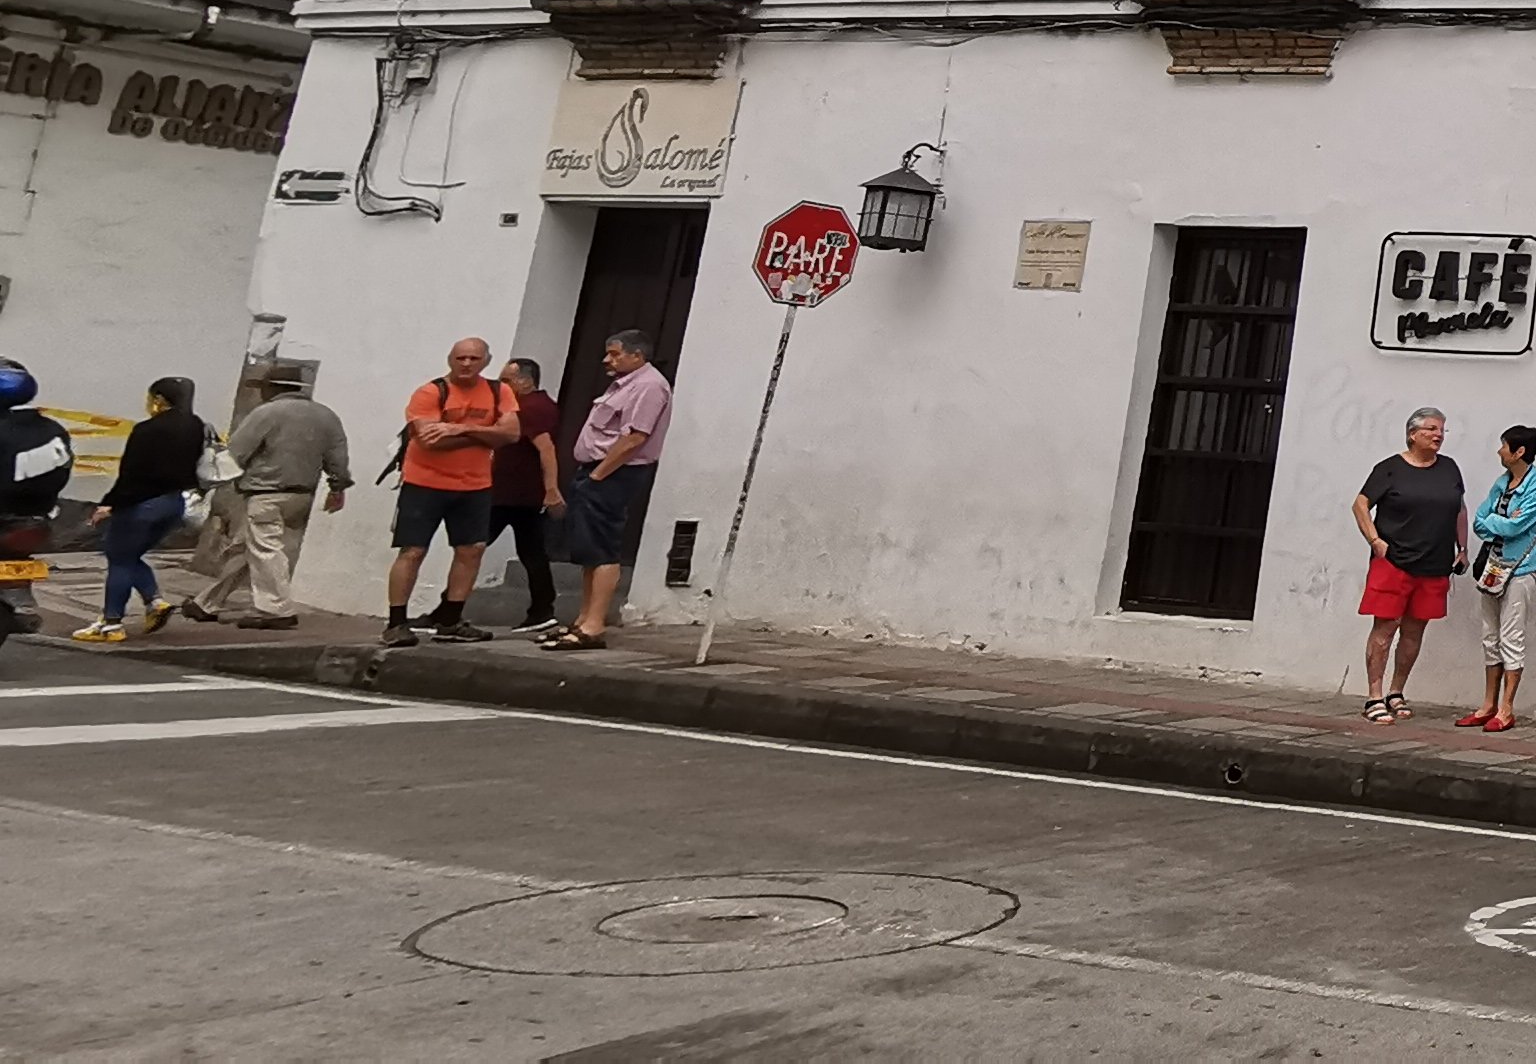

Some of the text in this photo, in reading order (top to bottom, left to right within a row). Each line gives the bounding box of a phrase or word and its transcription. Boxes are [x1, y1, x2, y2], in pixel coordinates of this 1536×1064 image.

[546, 87, 725, 188] Fajas Salomé
[765, 231, 845, 277] PARE
[1392, 238, 1532, 305] CAFÉ
